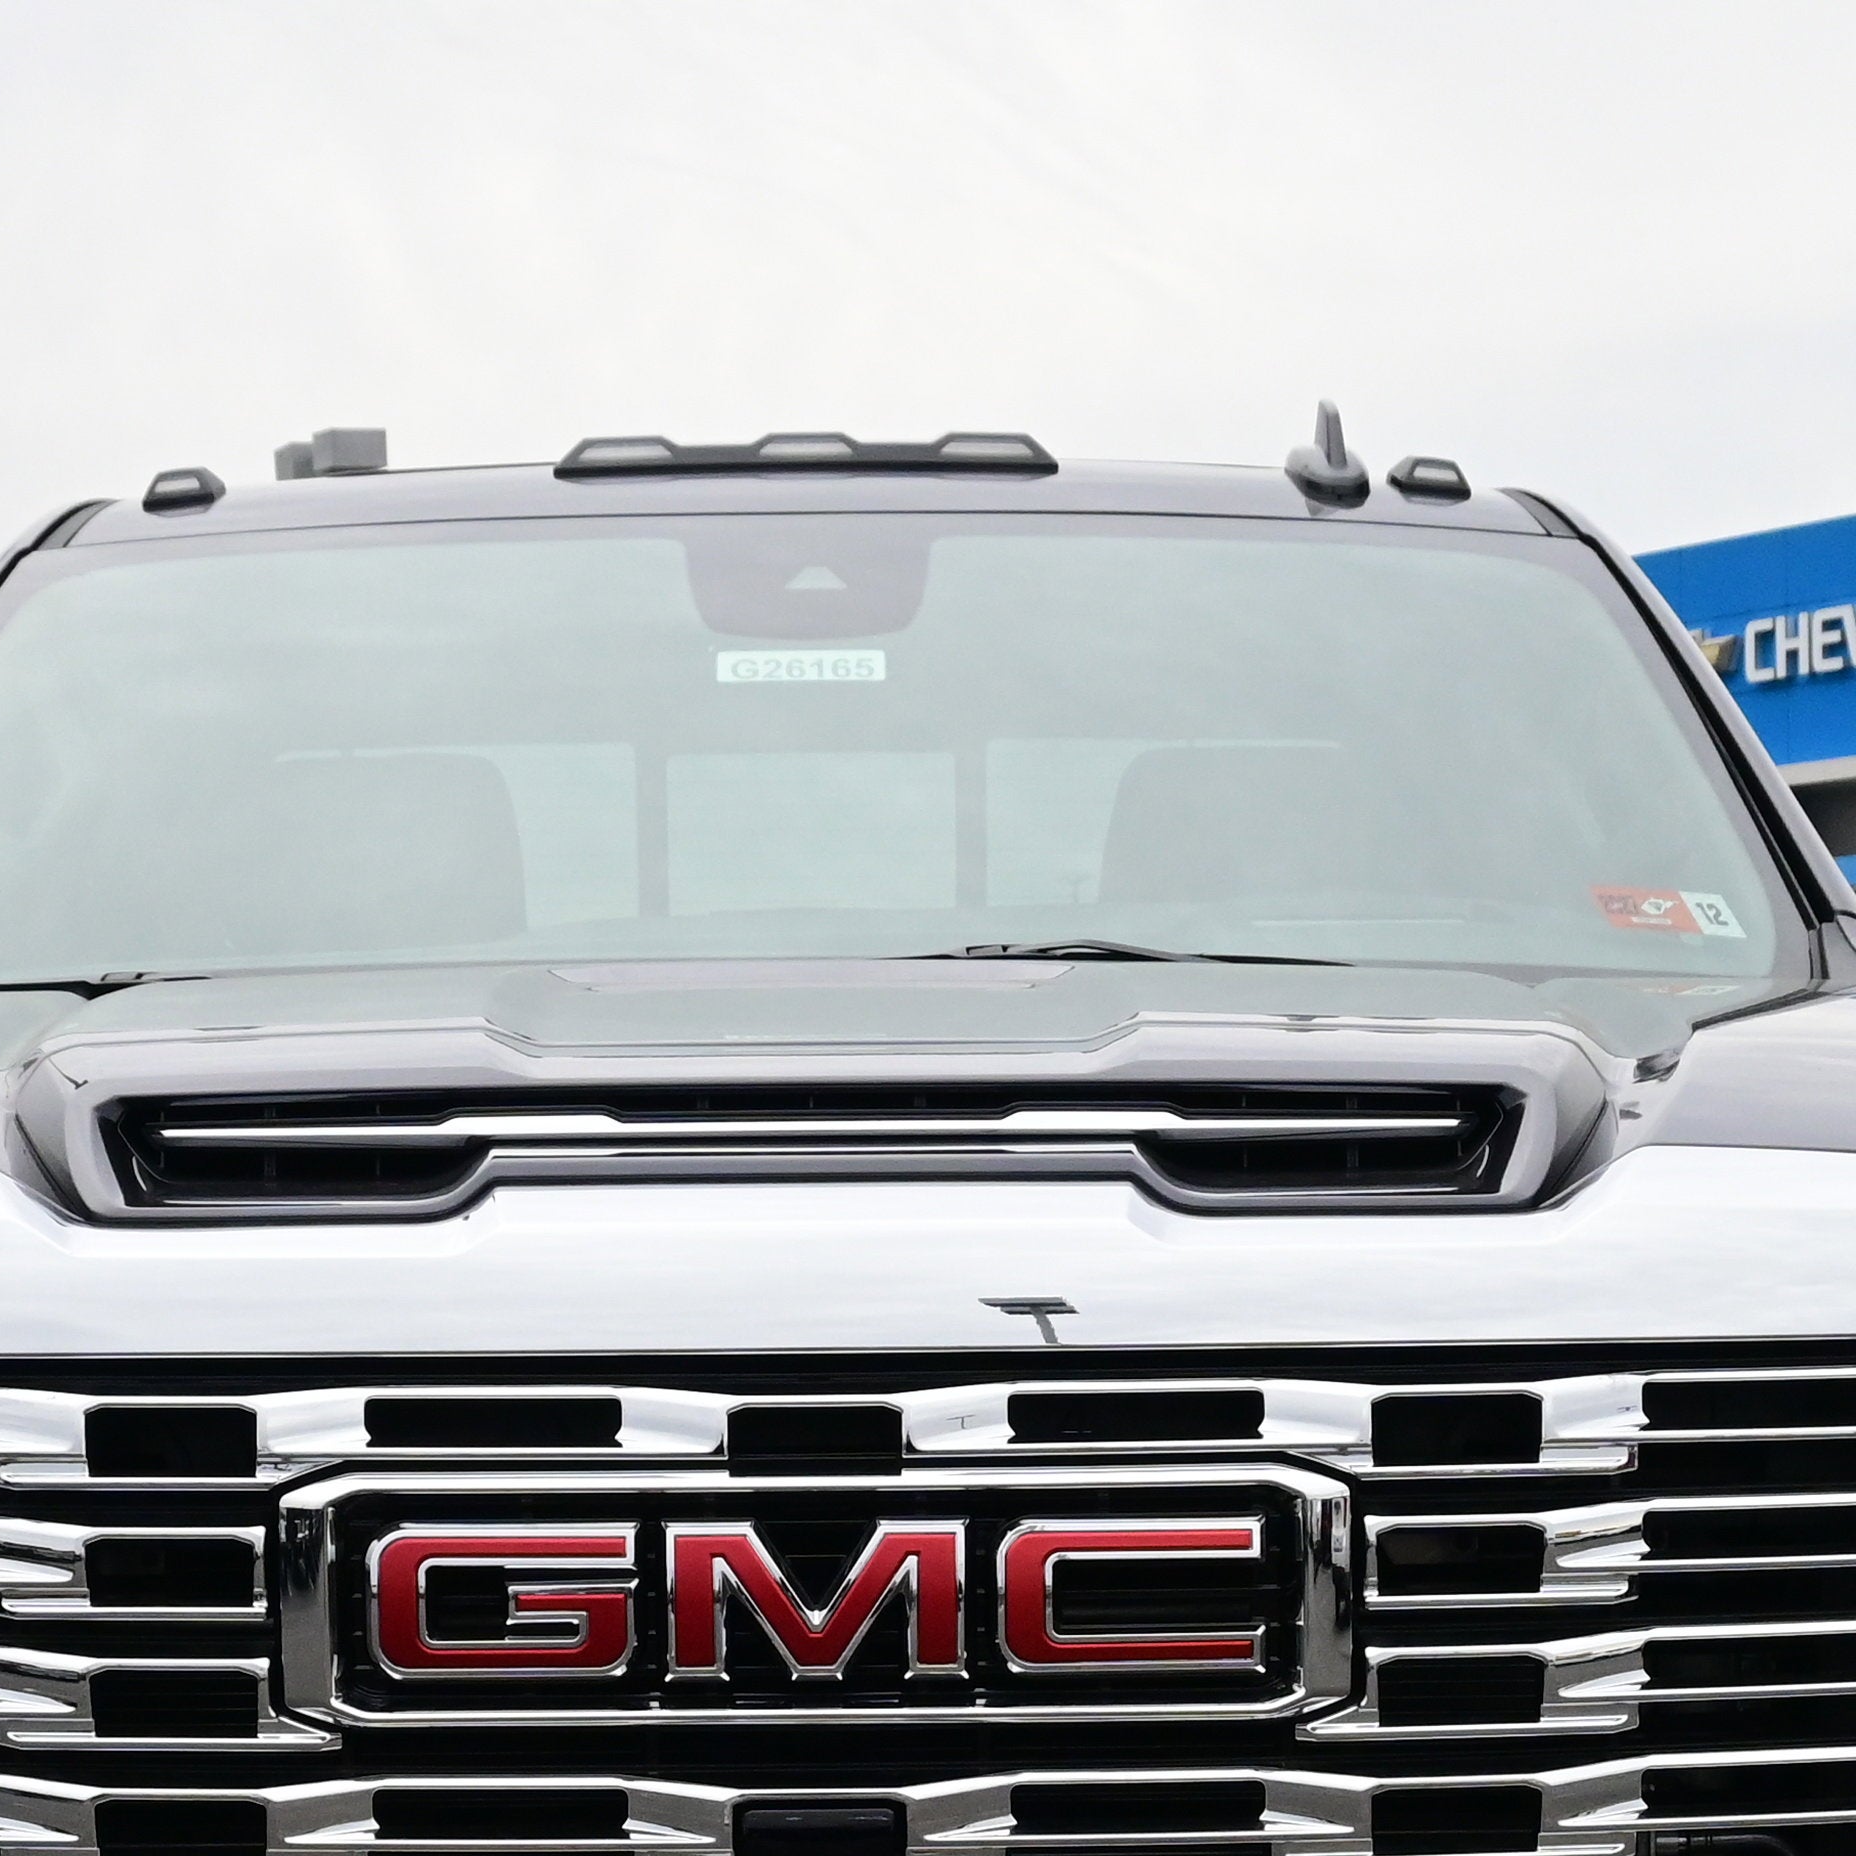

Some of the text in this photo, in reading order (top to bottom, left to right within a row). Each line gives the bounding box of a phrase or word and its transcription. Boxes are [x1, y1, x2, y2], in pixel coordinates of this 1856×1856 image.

[730, 657, 876, 680] G26165
[1695, 901, 1729, 926] 12
[366, 1516, 1269, 1682] GMC
